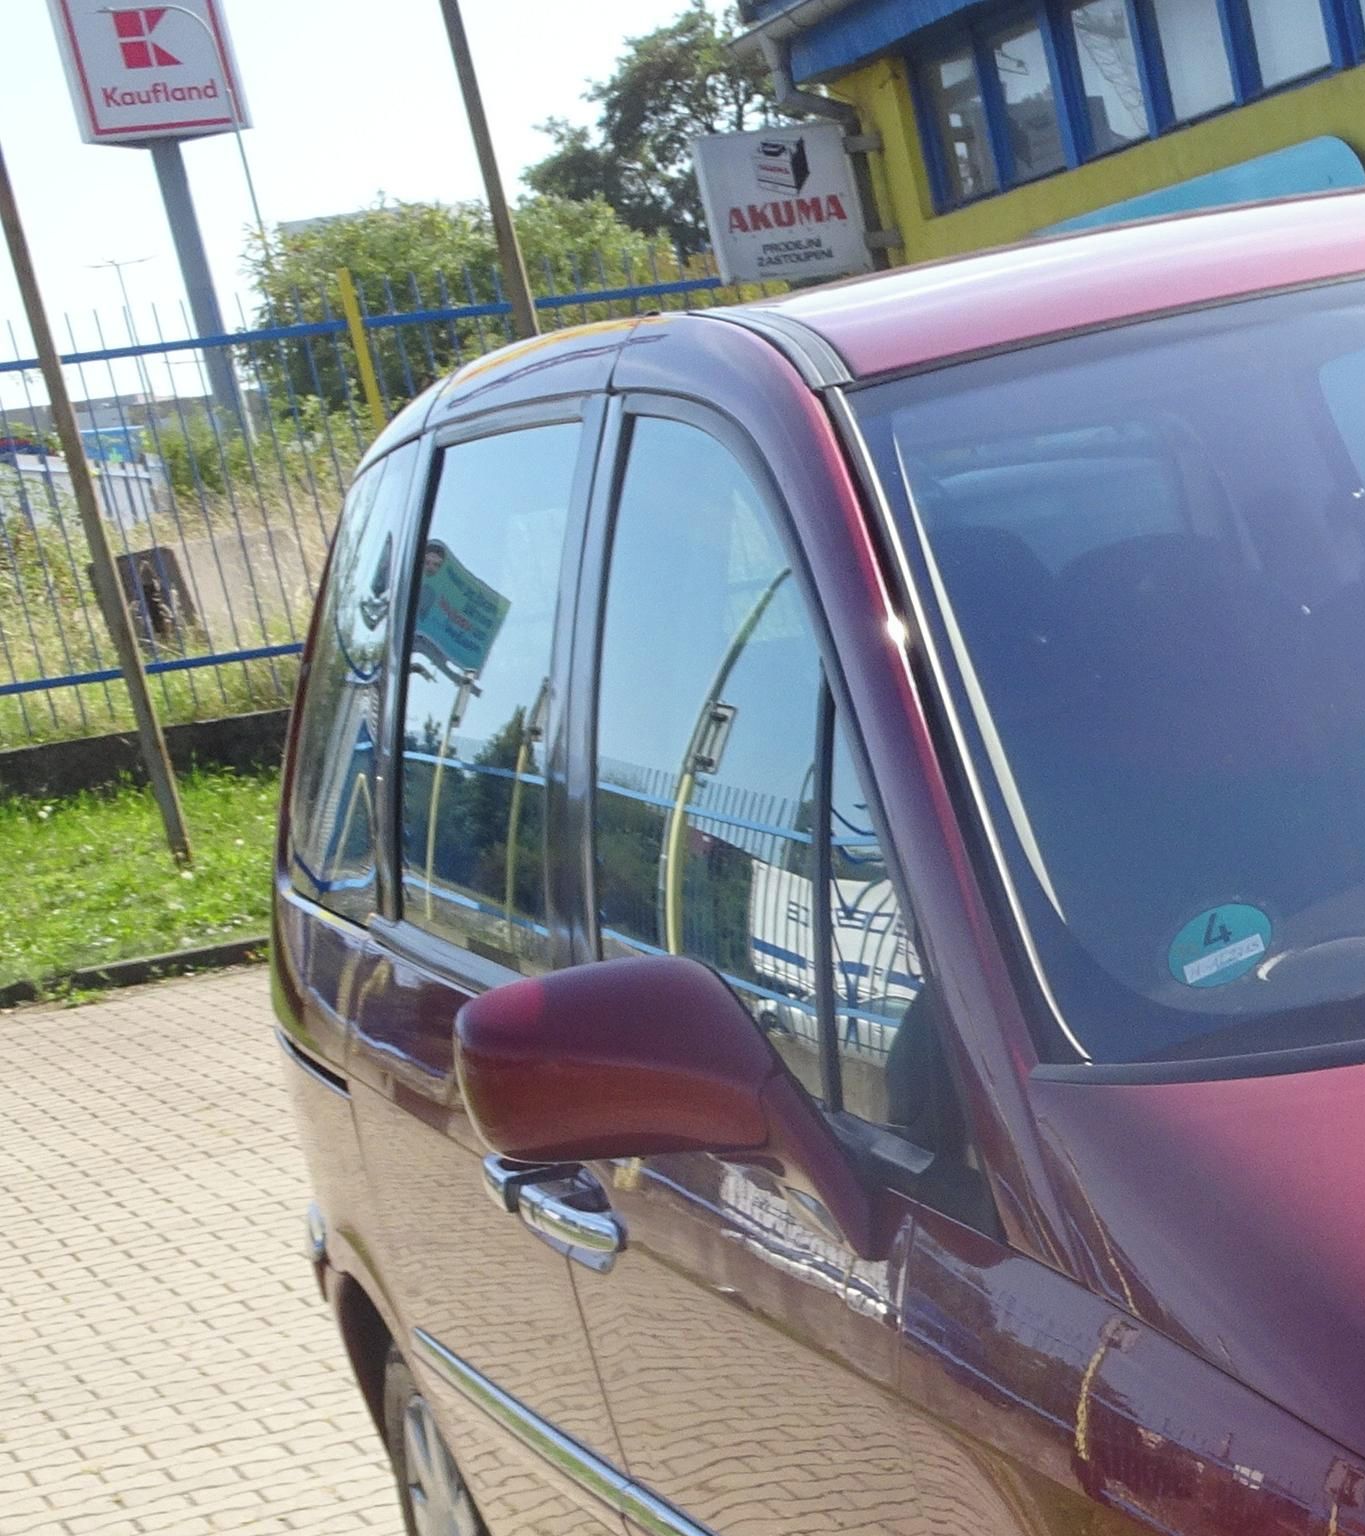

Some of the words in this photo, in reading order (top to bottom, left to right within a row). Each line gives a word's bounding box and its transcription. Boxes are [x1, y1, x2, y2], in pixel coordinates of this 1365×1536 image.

[111, 8, 183, 69] K
[101, 79, 218, 108] Kaufland
[728, 194, 848, 234] AKUMA
[1203, 912, 1232, 946] 4
